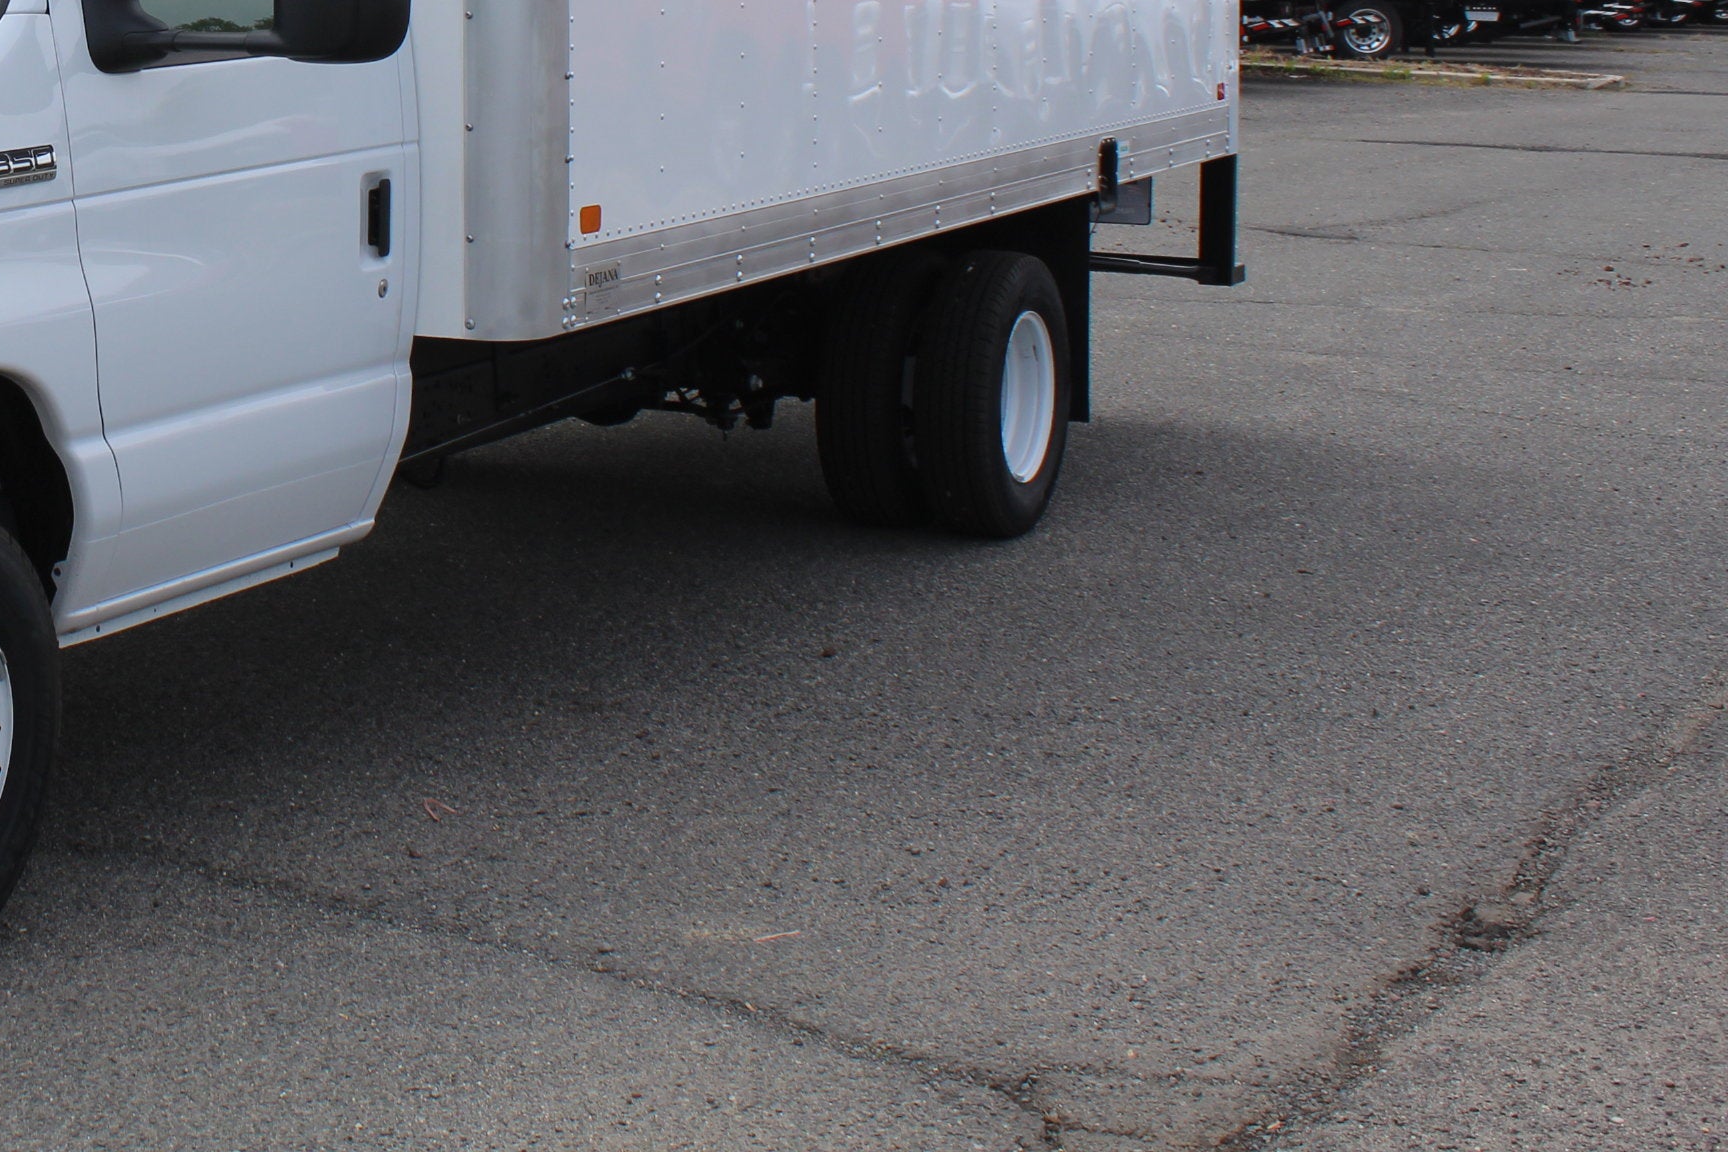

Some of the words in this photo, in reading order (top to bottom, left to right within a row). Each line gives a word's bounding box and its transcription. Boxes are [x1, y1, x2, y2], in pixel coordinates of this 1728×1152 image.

[3, 176, 31, 186] SUPER
[33, 172, 54, 181] DUTY
[588, 269, 619, 288] DEJANA
